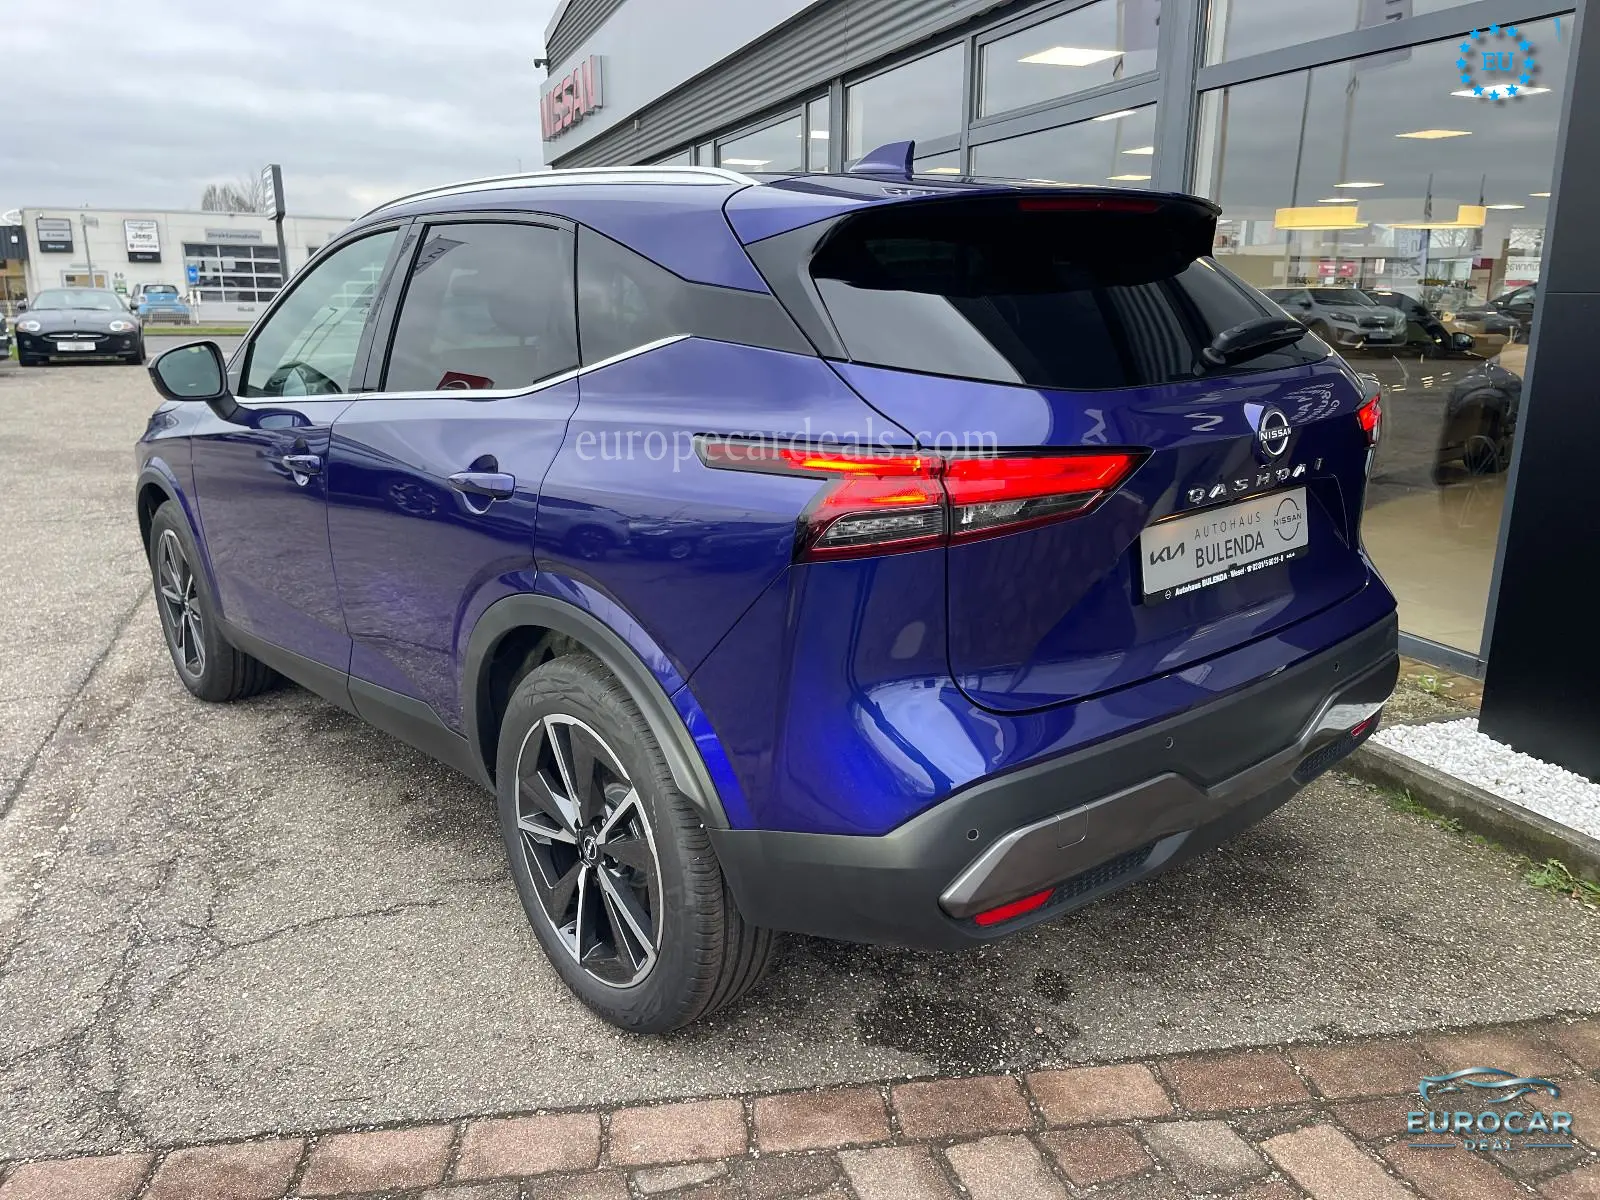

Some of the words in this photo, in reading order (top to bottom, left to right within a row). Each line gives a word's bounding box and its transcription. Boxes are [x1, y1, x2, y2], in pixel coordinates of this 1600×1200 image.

[1259, 426, 1292, 442] NISSAN
[1187, 457, 1324, 505] QASHQAI
[1194, 511, 1262, 541] AUTOHAUS
[1273, 511, 1303, 527] NISSAN
[1195, 530, 1265, 568] BULENDA
[1174, 582, 1202, 597] Autohaus
[1202, 572, 1228, 588] BULENDA
